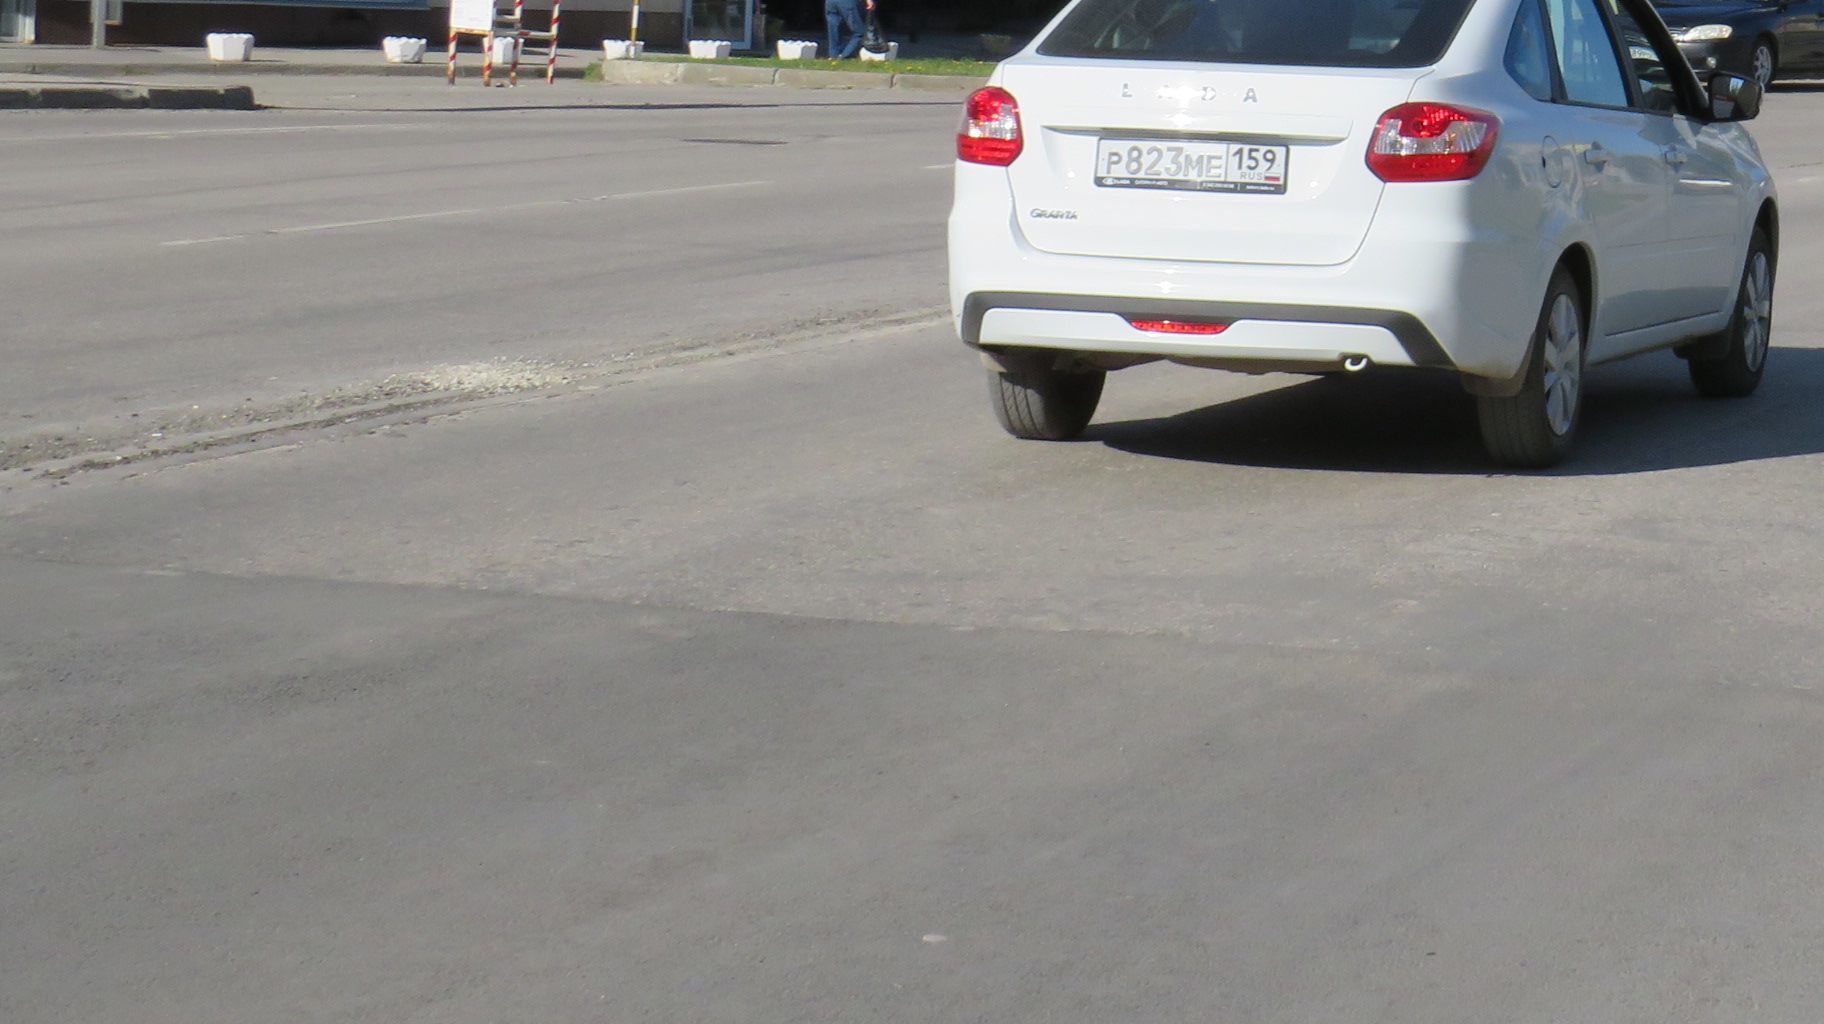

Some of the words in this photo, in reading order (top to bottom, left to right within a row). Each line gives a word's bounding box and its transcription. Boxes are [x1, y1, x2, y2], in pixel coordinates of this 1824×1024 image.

[1121, 82, 1258, 103] LDA
[1232, 147, 1277, 172] 159
[1240, 171, 1263, 181] RUS
